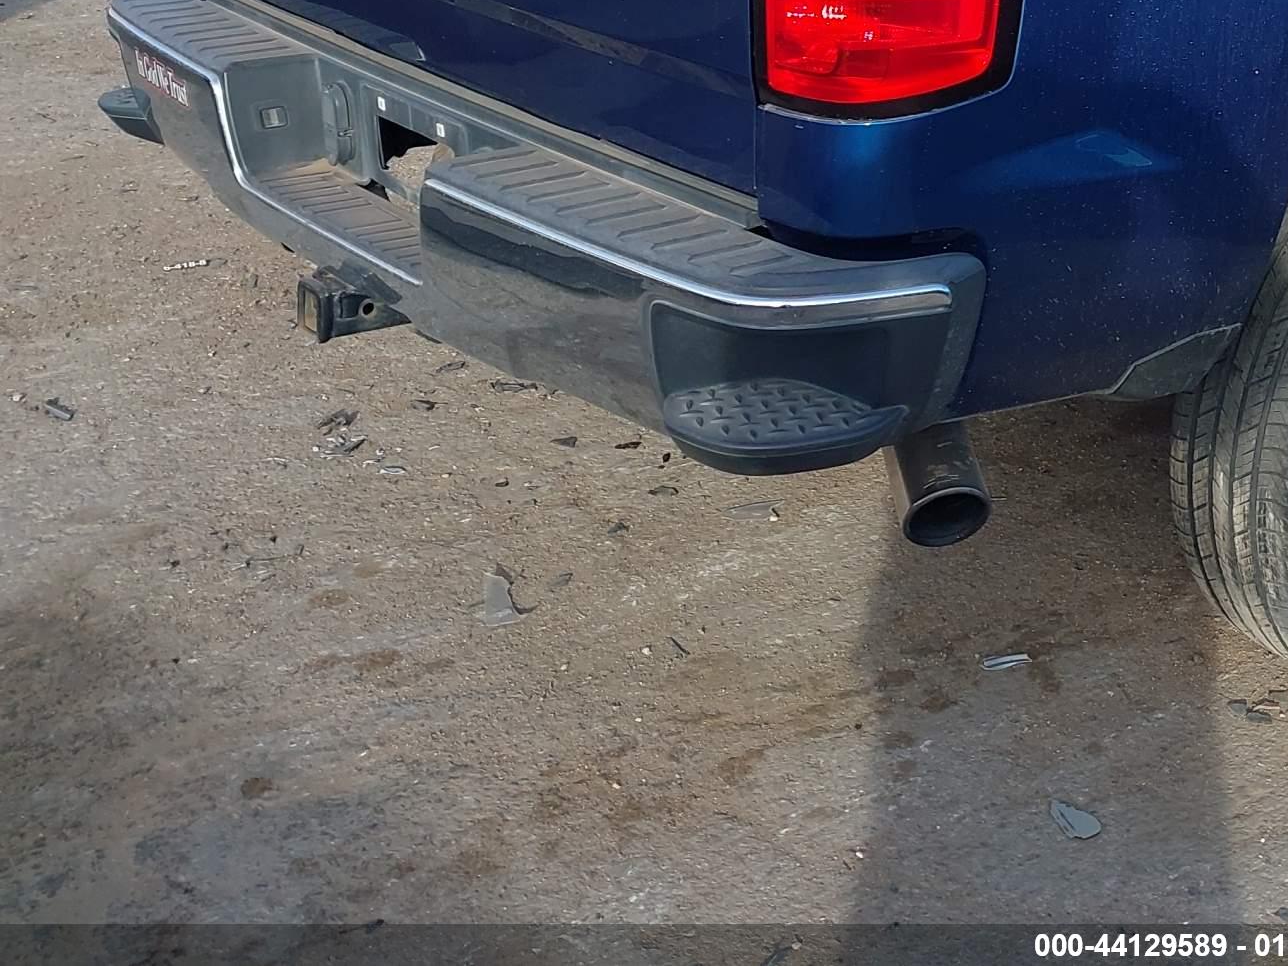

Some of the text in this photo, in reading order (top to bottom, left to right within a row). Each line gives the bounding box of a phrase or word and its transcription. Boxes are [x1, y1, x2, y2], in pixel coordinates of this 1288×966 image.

[143, 55, 160, 88] God
[156, 64, 170, 95] We
[167, 71, 189, 107] Trust
